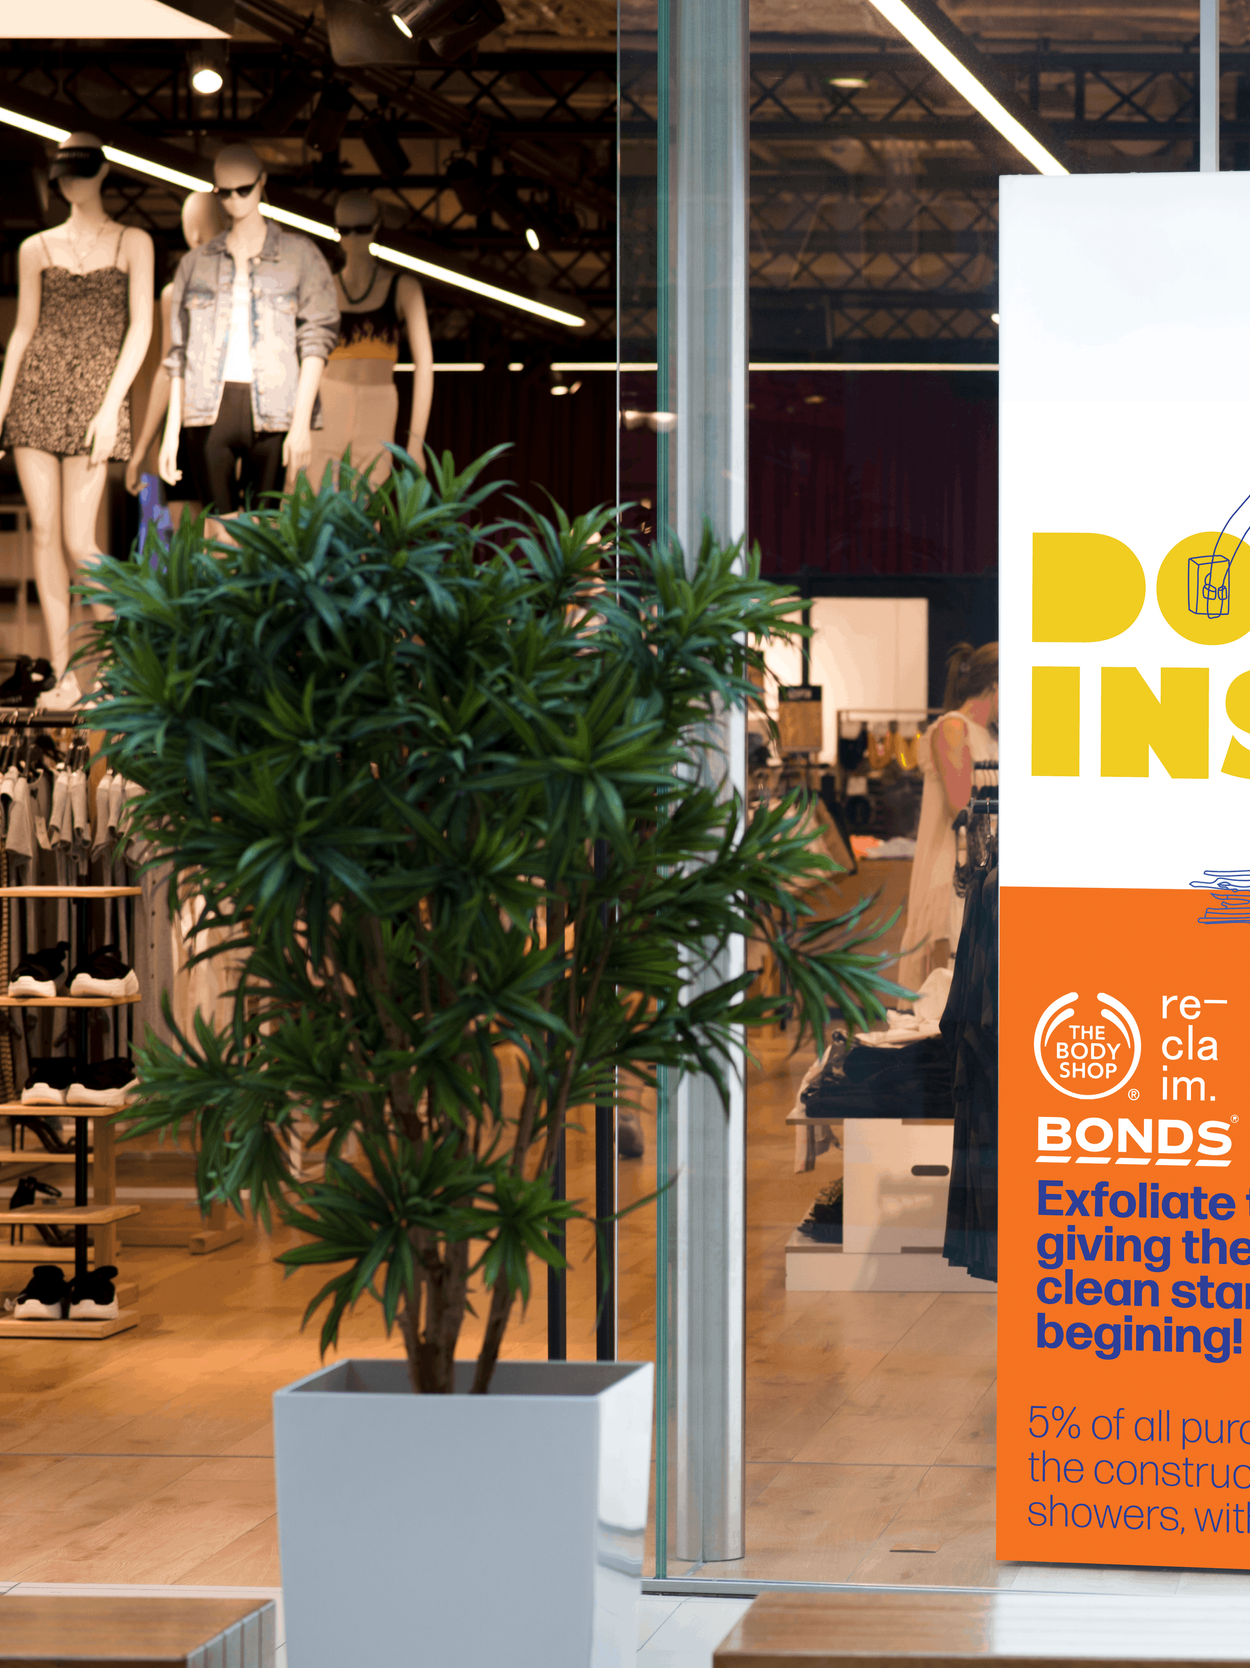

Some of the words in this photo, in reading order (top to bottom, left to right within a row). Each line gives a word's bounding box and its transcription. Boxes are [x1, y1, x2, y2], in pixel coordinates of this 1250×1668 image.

[1056, 1041, 1121, 1061] BODY
[1068, 1024, 1106, 1041] THE
[1161, 1024, 1219, 1061] cla
[1059, 1061, 1118, 1080] SHOP
[1162, 1064, 1216, 1102] im.
[1037, 1116, 1233, 1156] BONDS
[1037, 1179, 1237, 1221] Exfoliate
[1036, 1224, 1171, 1273] giving
[1036, 1269, 1160, 1308] clean
[1036, 1312, 1242, 1364] begining!
[1028, 1405, 1081, 1440] 5%
[1091, 1407, 1125, 1441] of
[1134, 1409, 1170, 1442] all
[1028, 1449, 1085, 1484] the
[1027, 1494, 1185, 1535] showers,
